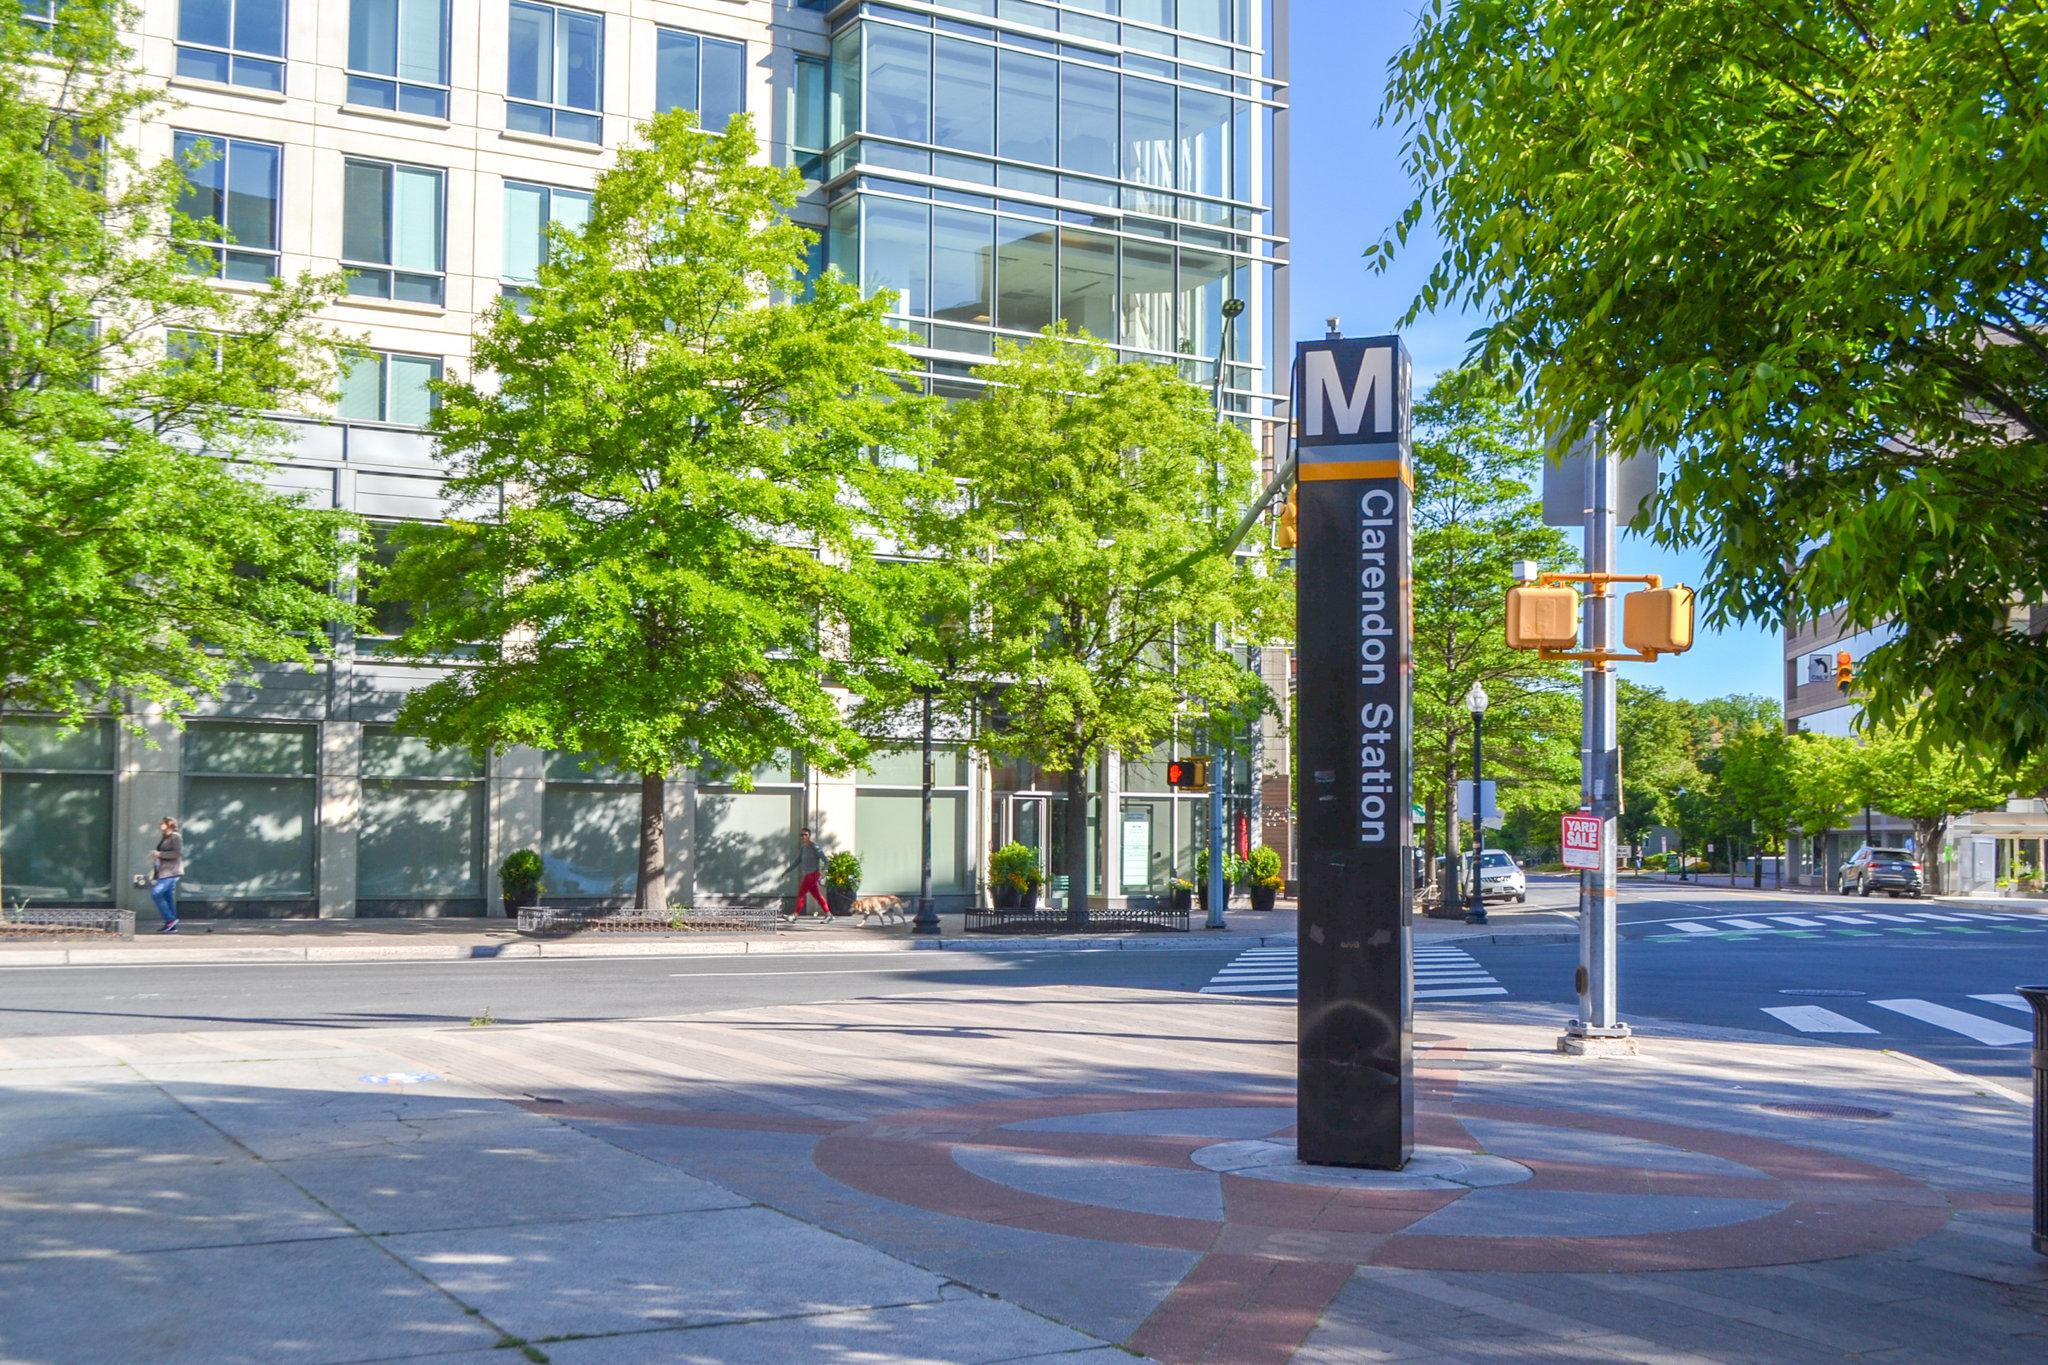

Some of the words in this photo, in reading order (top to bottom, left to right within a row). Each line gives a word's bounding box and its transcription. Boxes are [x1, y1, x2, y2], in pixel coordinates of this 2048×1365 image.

[1306, 347, 1392, 436] M
[1361, 489, 1394, 685] Clarendon
[1361, 702, 1394, 843] Station
[1566, 820, 1598, 833] YARD
[1566, 831, 1598, 848] SALE
